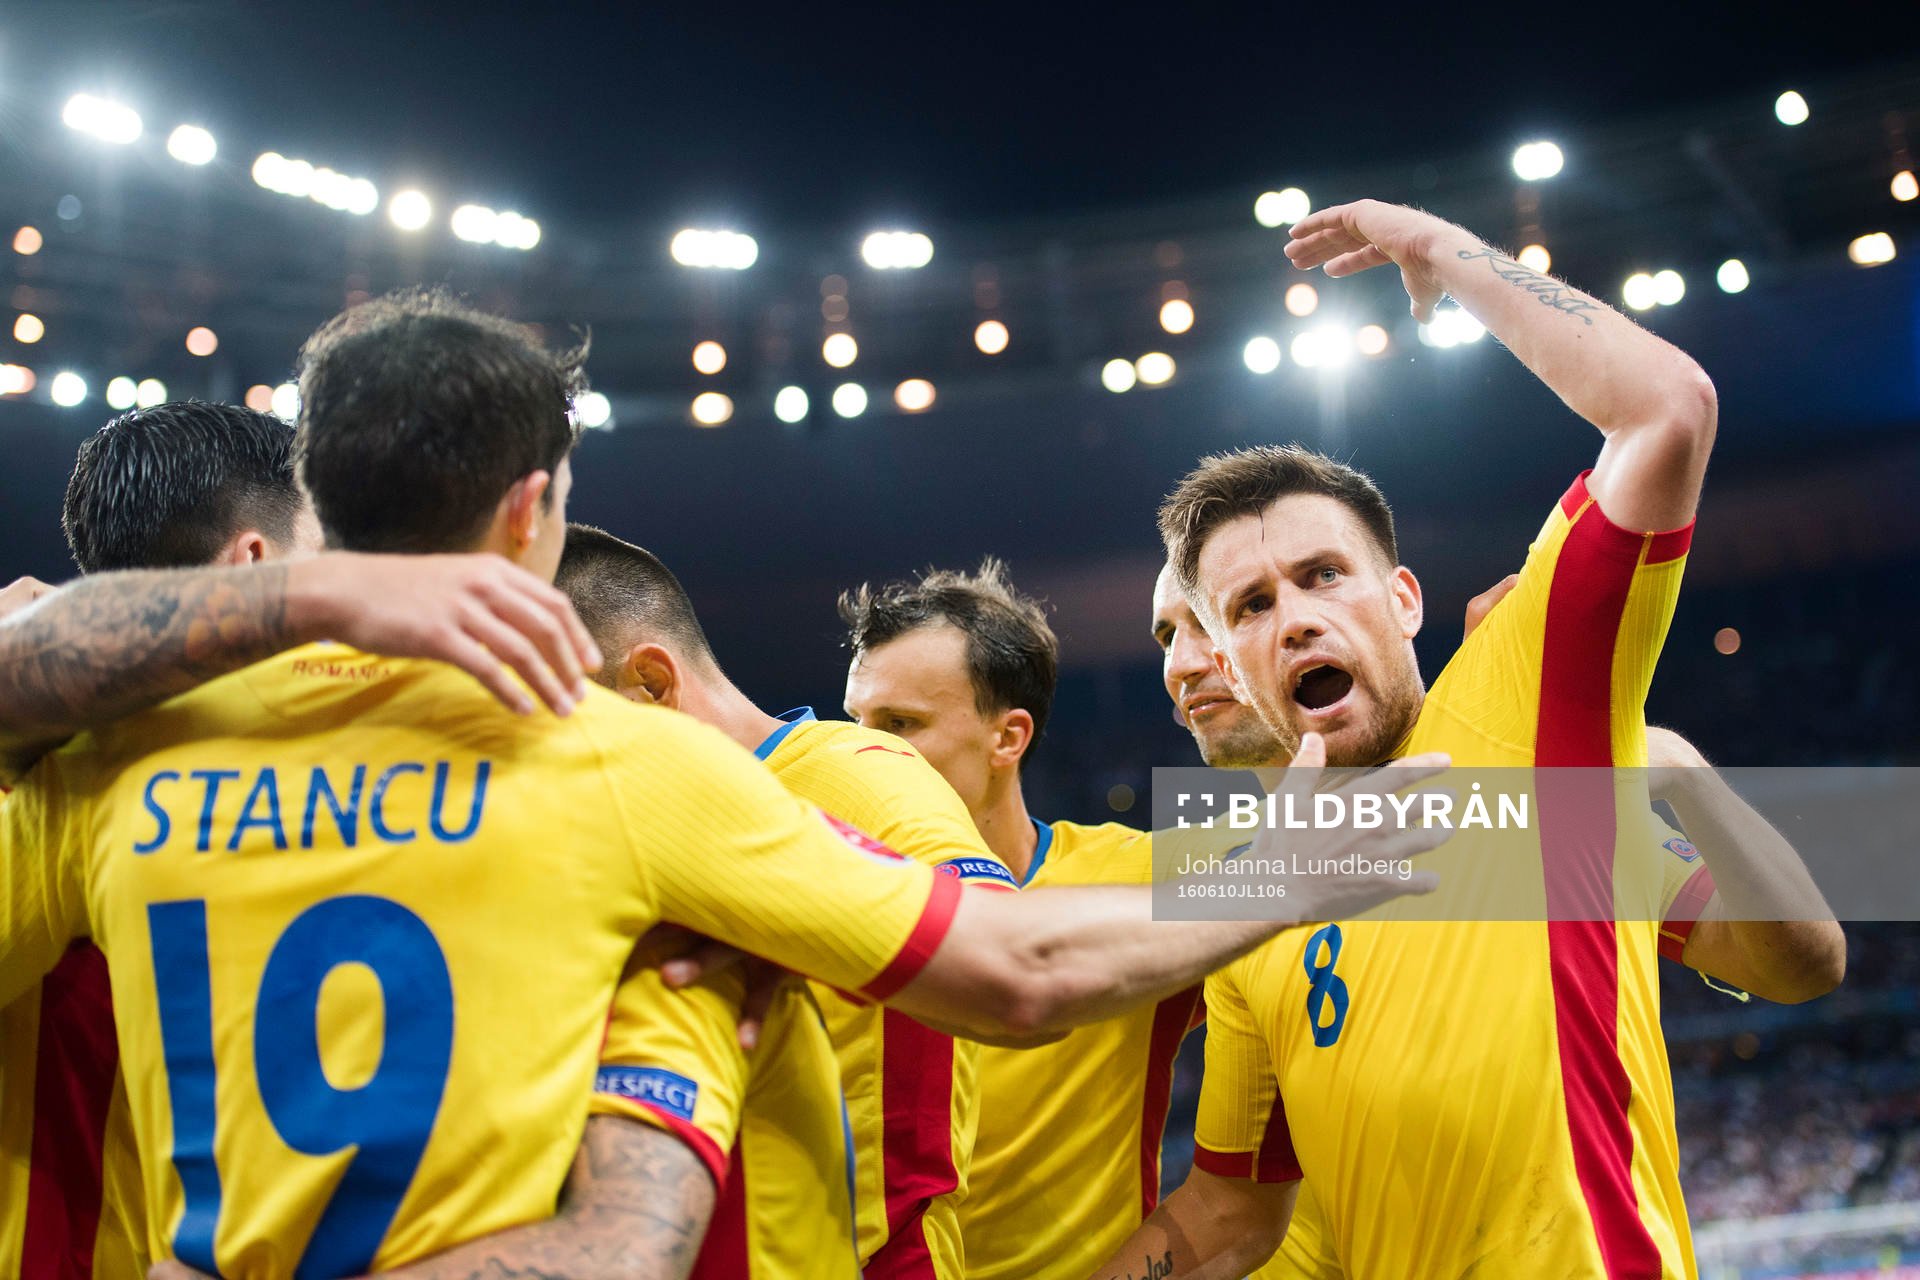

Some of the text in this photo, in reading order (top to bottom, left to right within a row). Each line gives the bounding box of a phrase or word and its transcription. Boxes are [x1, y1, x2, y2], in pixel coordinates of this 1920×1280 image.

[133, 760, 491, 854] STANCU
[960, 862, 1017, 884] RESP
[1303, 922, 1349, 1048] 8
[147, 894, 454, 1280] 19
[594, 1072, 697, 1111] RESPECT
